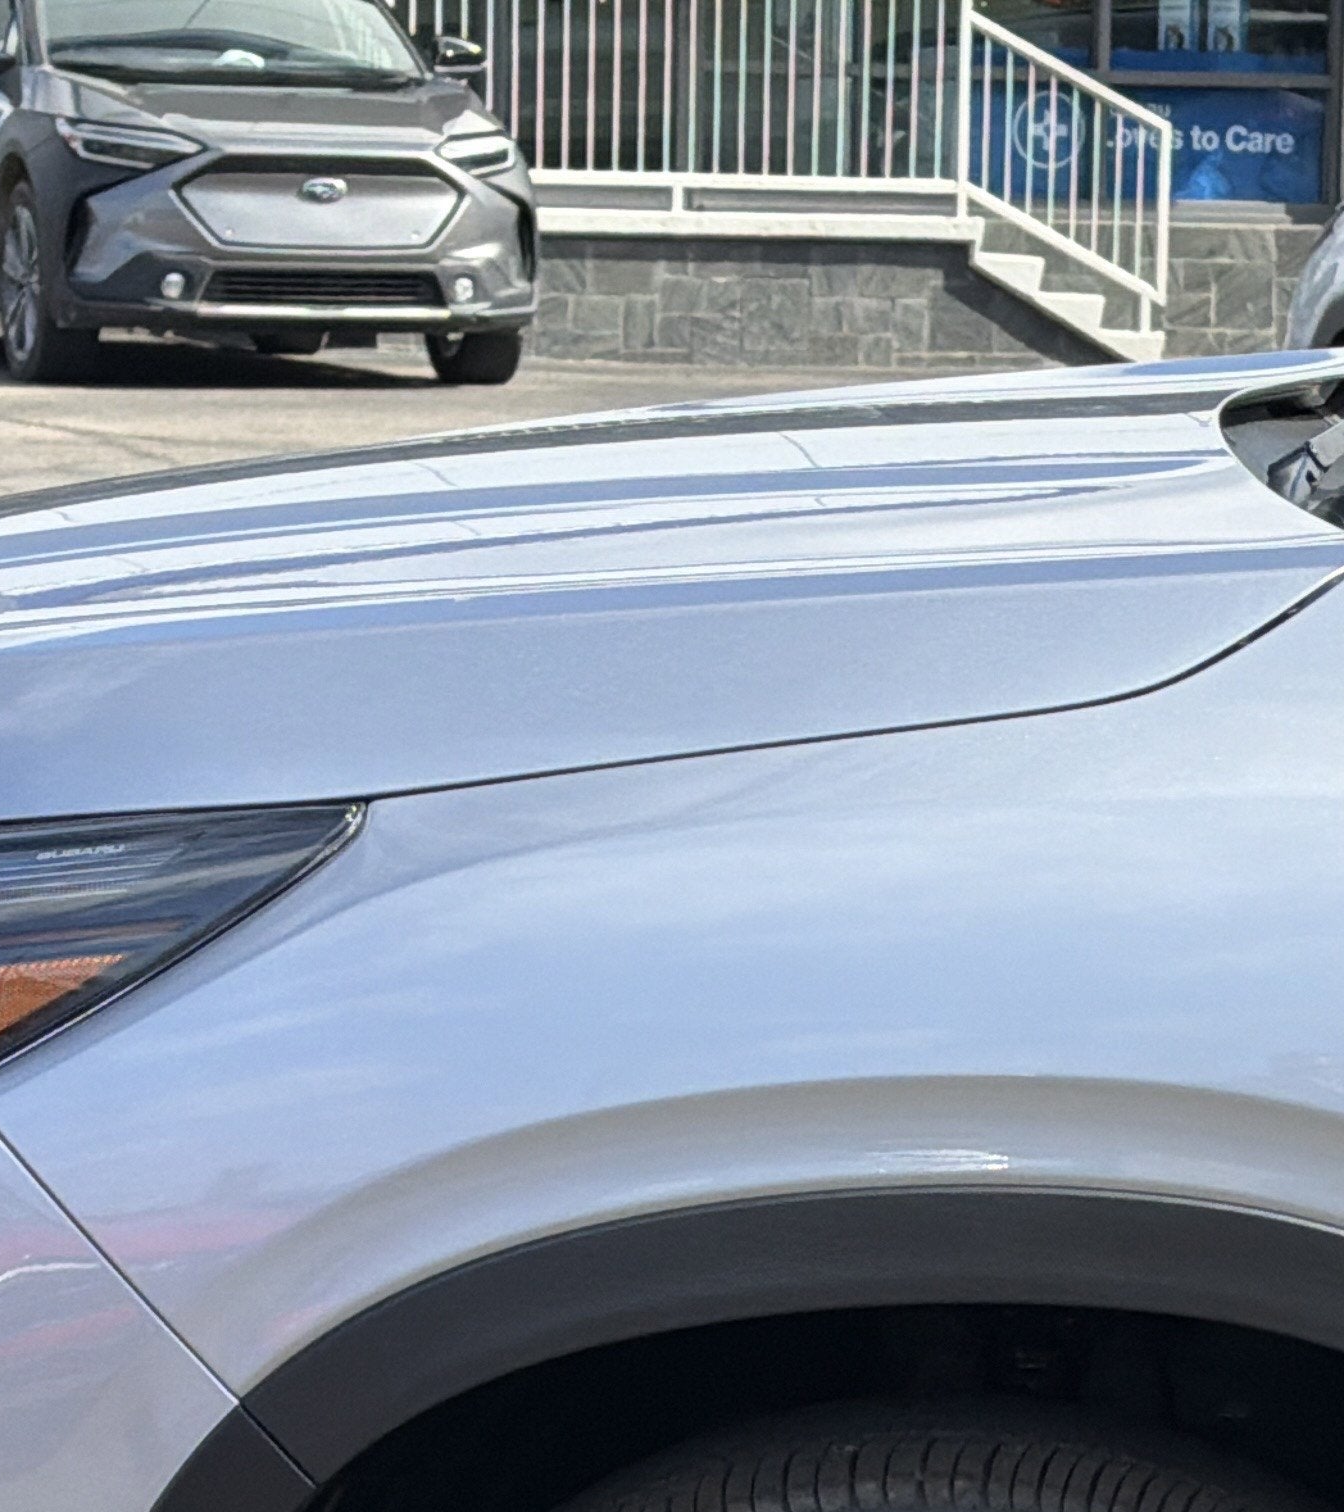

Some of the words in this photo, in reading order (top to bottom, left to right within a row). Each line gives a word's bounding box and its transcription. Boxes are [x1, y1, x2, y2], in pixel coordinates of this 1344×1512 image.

[1190, 125, 1220, 151] to
[1225, 125, 1295, 154] Care
[36, 843, 125, 860] SUBARU
